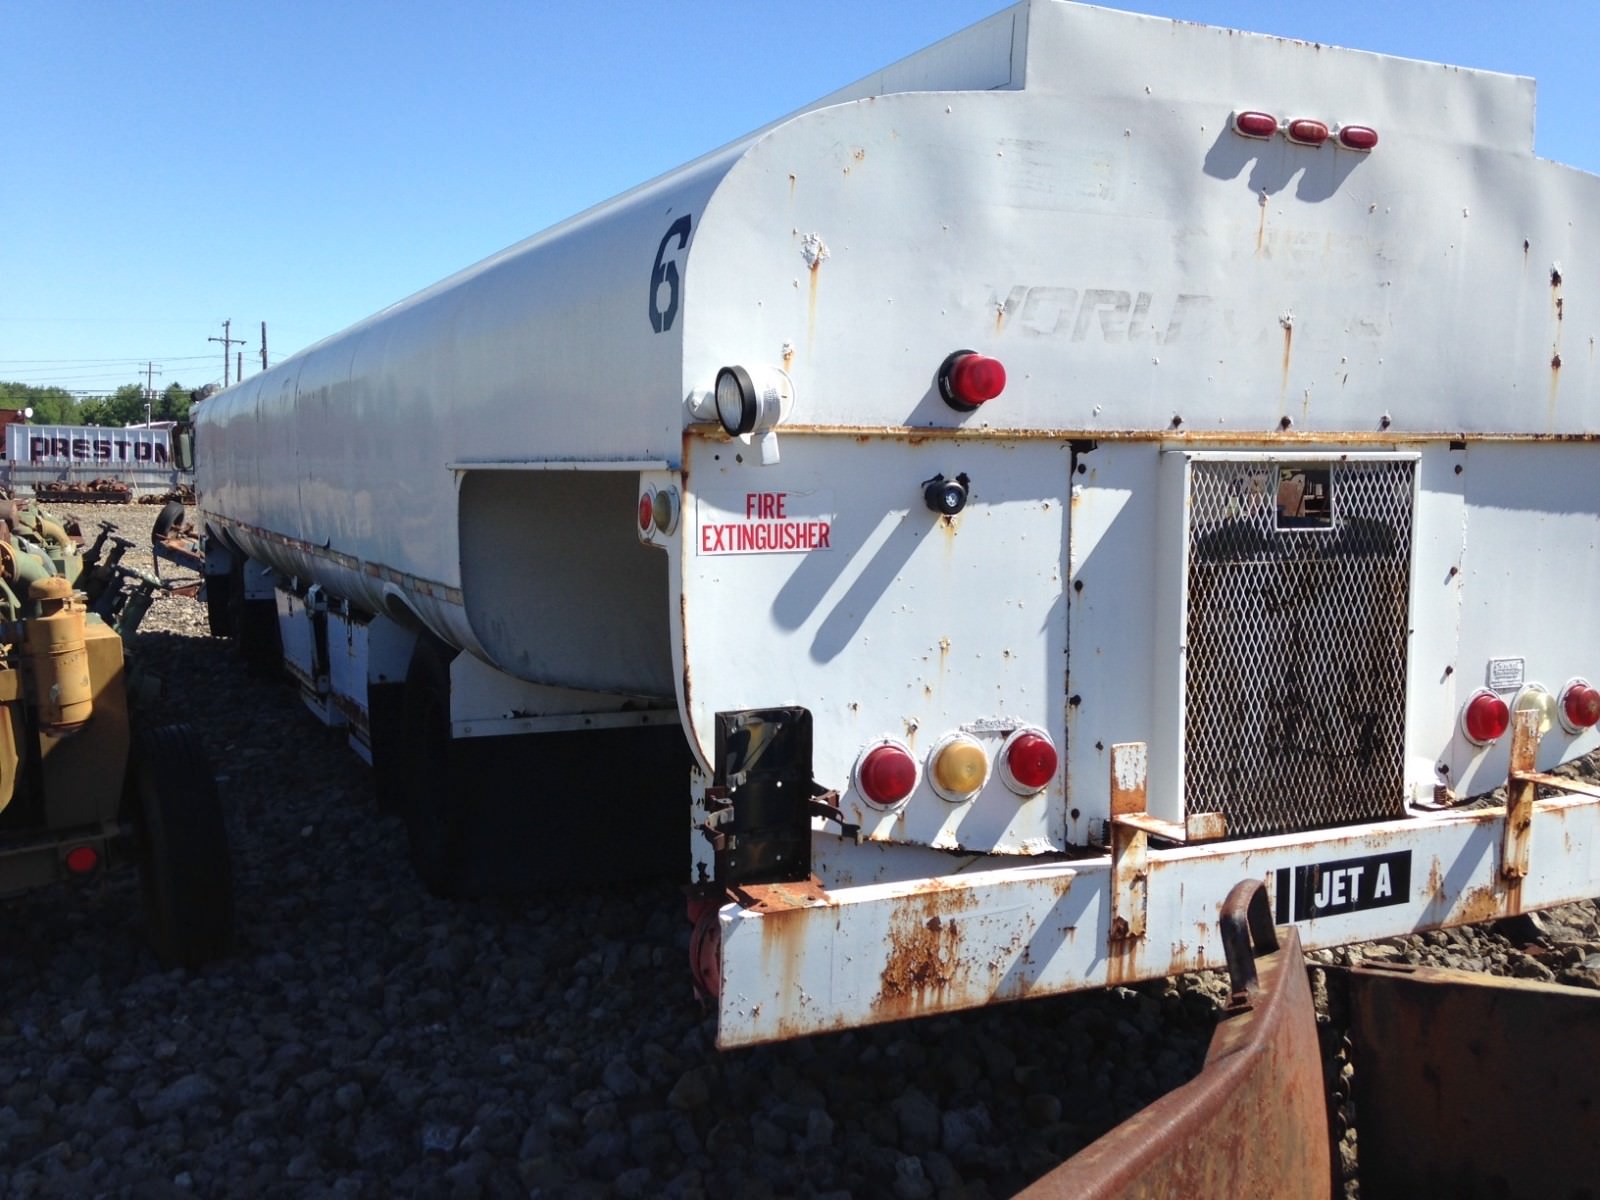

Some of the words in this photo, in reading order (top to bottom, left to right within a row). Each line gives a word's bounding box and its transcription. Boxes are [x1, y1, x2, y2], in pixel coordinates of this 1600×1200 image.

[648, 213, 692, 334] 6
[30, 436, 168, 463] PRESTON
[746, 492, 787, 520] FIRE
[702, 522, 830, 551] EXTINGUISHER
[1314, 866, 1365, 908] JET
[1374, 862, 1393, 899] A
